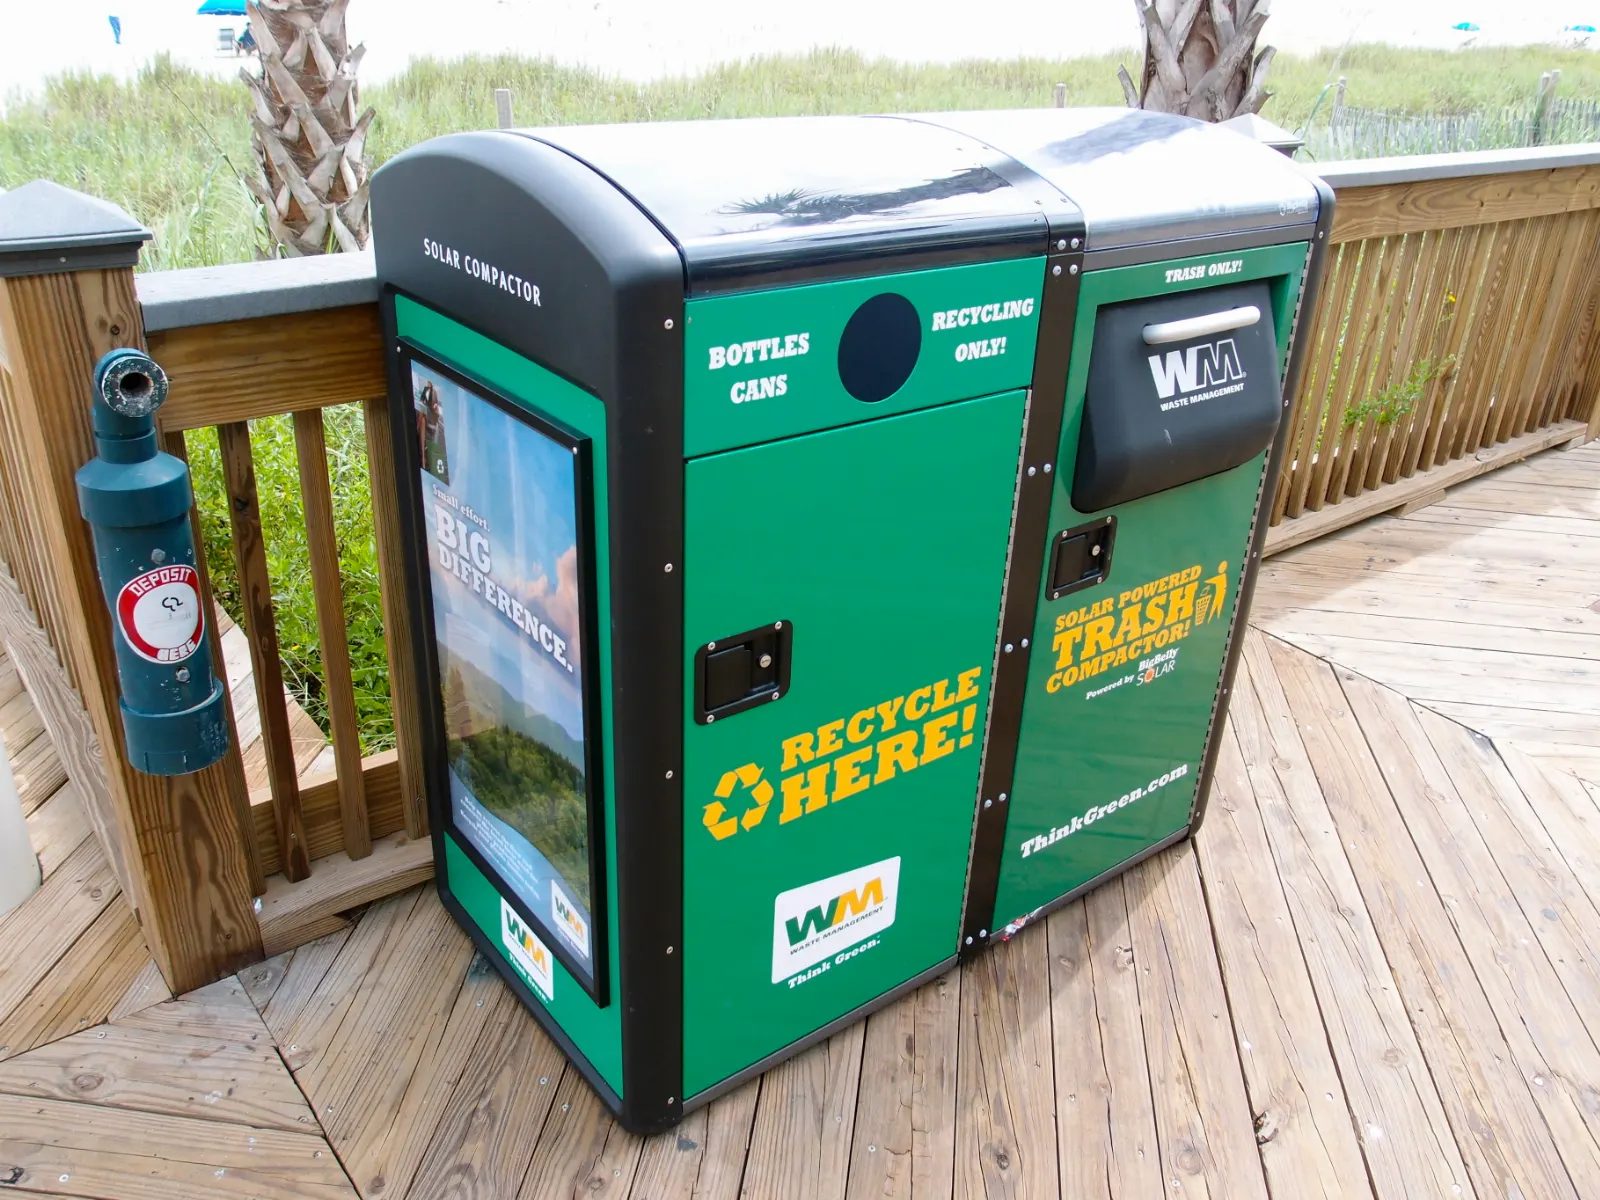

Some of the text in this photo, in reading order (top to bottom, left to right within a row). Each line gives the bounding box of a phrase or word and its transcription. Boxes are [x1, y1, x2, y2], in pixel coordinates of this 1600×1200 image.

[423, 237, 542, 307] SOLAR COMPACTOR
[1165, 259, 1243, 284] TRASH ONLY!
[931, 297, 1035, 332] RECYCLING
[708, 332, 811, 371] BOTTLES
[954, 336, 1007, 363] ONLY!
[1148, 338, 1243, 399] WM
[730, 374, 788, 405] CANS
[1160, 382, 1245, 412] WASTE MANAGEMENT
[432, 483, 491, 533] Small effort.
[434, 503, 491, 574] BIG
[128, 567, 192, 597] DEPOSIT
[1055, 564, 1202, 633] SOLAR POWERED
[439, 547, 573, 674] DIFFERENCE.
[1052, 581, 1198, 671] TRASH
[1046, 619, 1191, 694] COMPACTOR!
[1136, 659, 1176, 686] SOLAR
[1138, 646, 1180, 672] BigBelly
[1085, 674, 1135, 700] Powered by
[781, 666, 982, 773] RECYCLE
[779, 703, 977, 825] HERE!
[1020, 763, 1188, 859] ThinkGreen.com
[555, 895, 584, 939] WM
[785, 877, 884, 947] WM
[790, 905, 884, 956] WASTE MANAGEMENT
[506, 908, 547, 974] WM
[787, 961, 832, 989] Think
